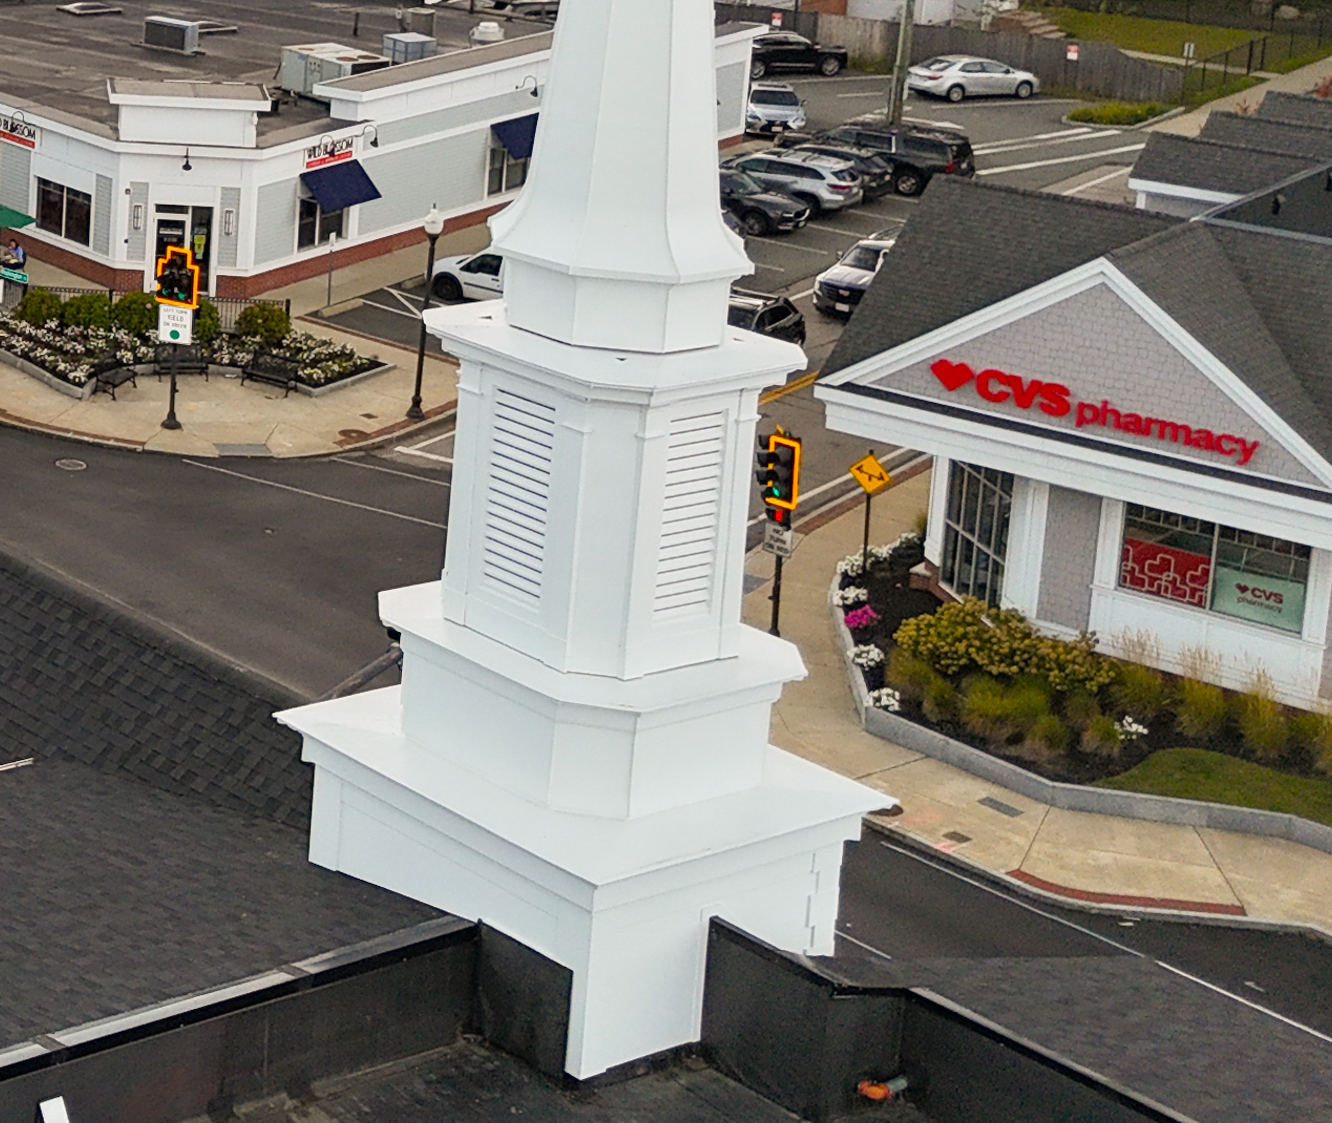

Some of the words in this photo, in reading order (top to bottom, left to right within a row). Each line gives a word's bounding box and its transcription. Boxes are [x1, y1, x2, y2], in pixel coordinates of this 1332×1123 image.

[3, 118, 36, 140] BLSSOM
[975, 369, 1071, 417] CVS
[1074, 399, 1260, 466] pharmacy
[1237, 596, 1283, 614] pharmacy
[1251, 587, 1284, 604] CVS
